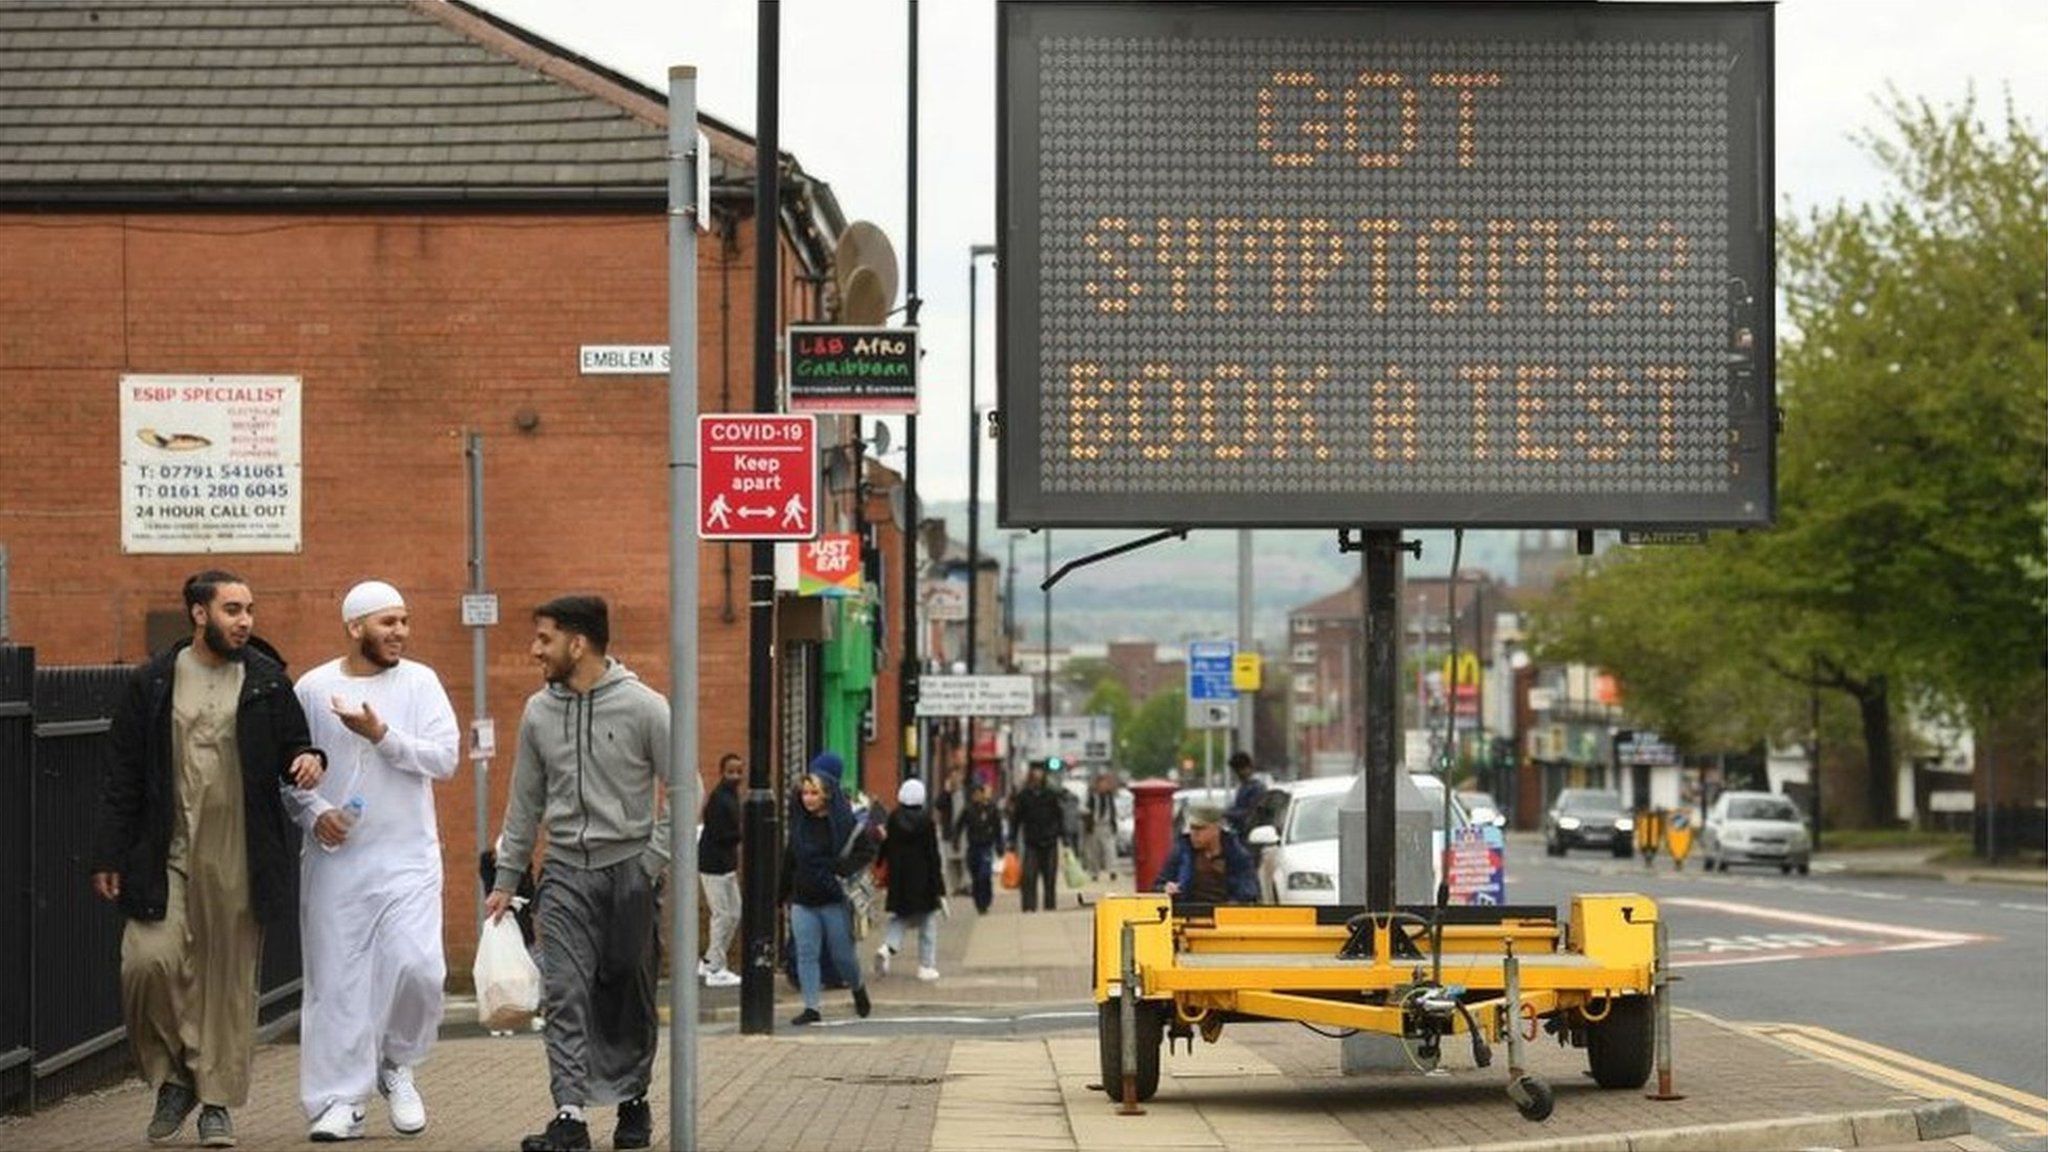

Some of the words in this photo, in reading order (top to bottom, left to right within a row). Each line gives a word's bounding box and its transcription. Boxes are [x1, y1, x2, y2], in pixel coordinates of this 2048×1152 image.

[1256, 71, 1503, 169] GOT
[1083, 216, 1689, 316] SYMPTOMS?
[583, 351, 655, 368] EMBLEM
[134, 387, 176, 402] ESBP
[182, 387, 285, 402] SPECIALIST
[1069, 362, 1331, 461] BOOK
[1372, 364, 1417, 461] A
[1460, 364, 1689, 461] TEST
[711, 424, 803, 441] COVID-19
[140, 466, 154, 479] T:
[161, 466, 214, 479] 07791
[221, 465, 285, 478] 541061
[734, 455, 780, 474] Keep
[138, 485, 152, 497] T:
[158, 485, 199, 497] 0161
[208, 484, 238, 497] 280
[245, 484, 288, 497] 6045
[732, 474, 782, 492] apart
[136, 506, 153, 518] 24
[160, 506, 204, 518] HOUR
[211, 506, 249, 517] CALL
[254, 505, 286, 517] OUT
[808, 540, 850, 559] JUST
[816, 557, 851, 572] EAT
